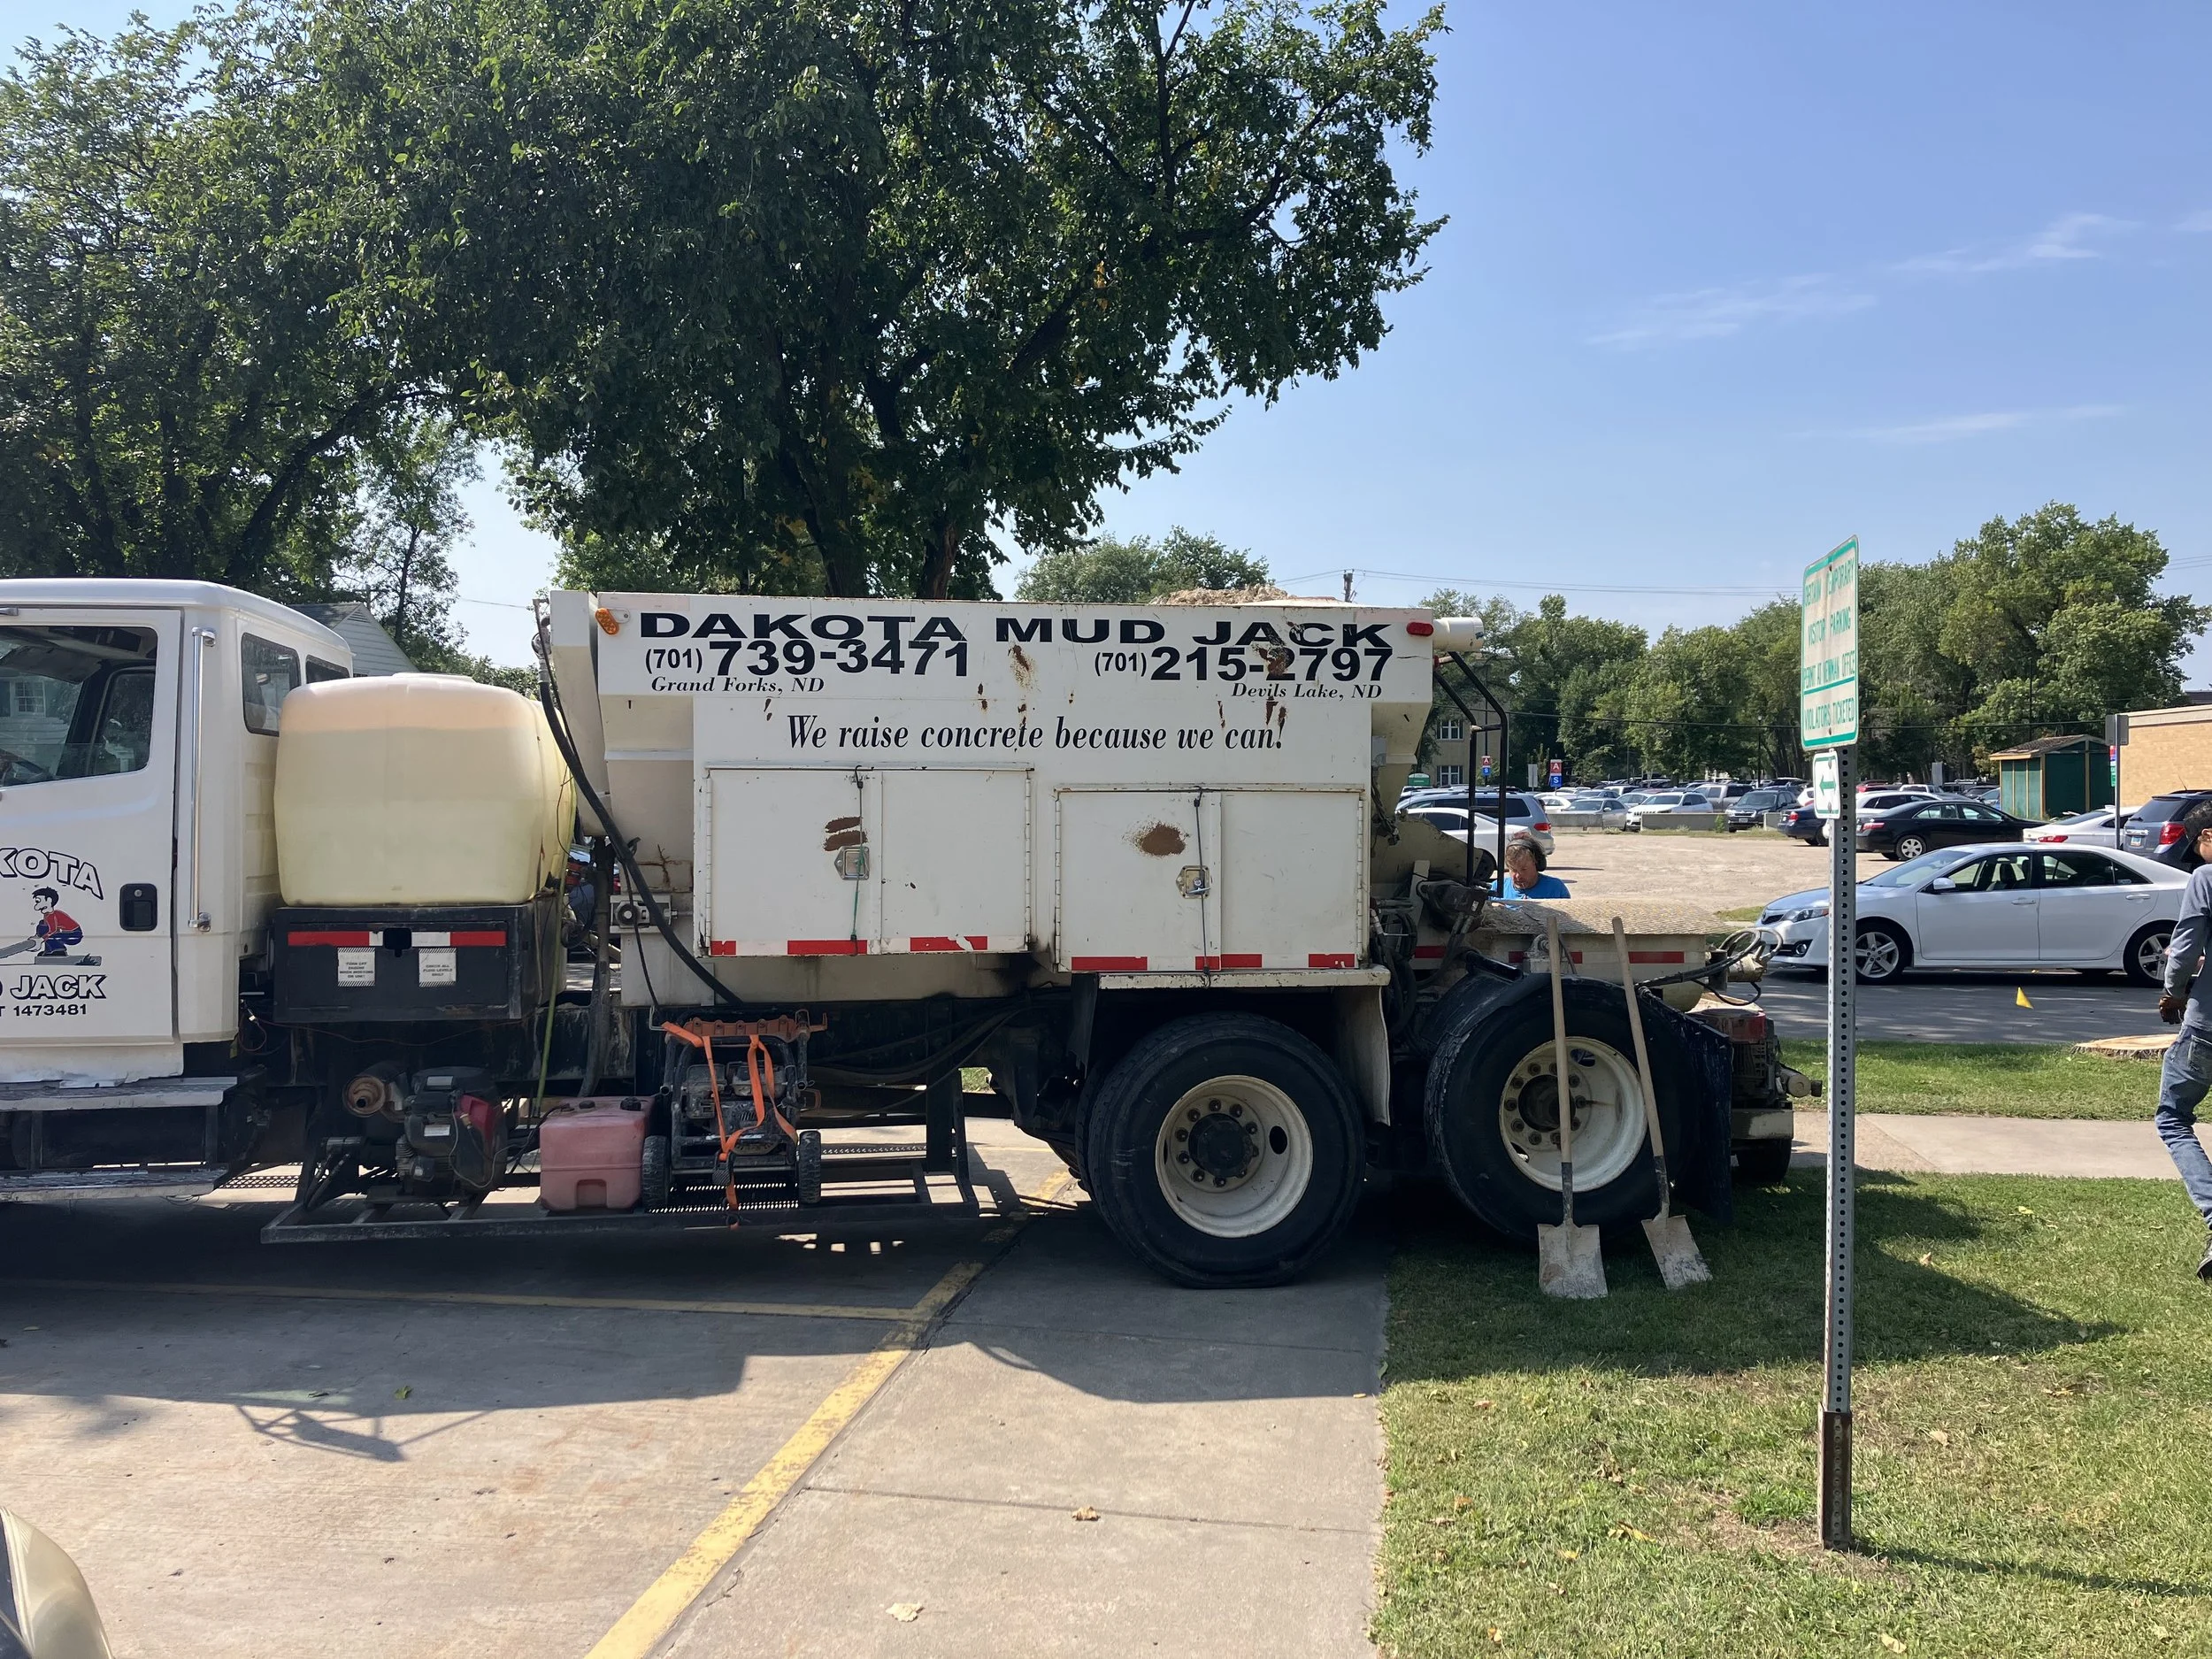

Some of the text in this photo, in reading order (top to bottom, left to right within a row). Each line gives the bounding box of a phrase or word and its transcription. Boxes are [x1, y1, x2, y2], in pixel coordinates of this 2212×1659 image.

[640, 612, 1393, 649] DAKOTA MUD JACK
[1808, 606, 1851, 646] VISITOR PARKING
[645, 639, 968, 677] (701) 739-3471
[1094, 652, 1147, 677] (701)
[1842, 650, 1855, 679] OFFICE
[651, 676, 825, 695] Grand Forks, ND
[1232, 682, 1383, 701] Devils Lake, ND
[1804, 697, 1855, 731] VIOLATORS TICKETED
[787, 715, 1286, 749] We raise concrete because we can!
[10, 975, 107, 1000] JACK
[13, 1004, 87, 1017] 1473481
